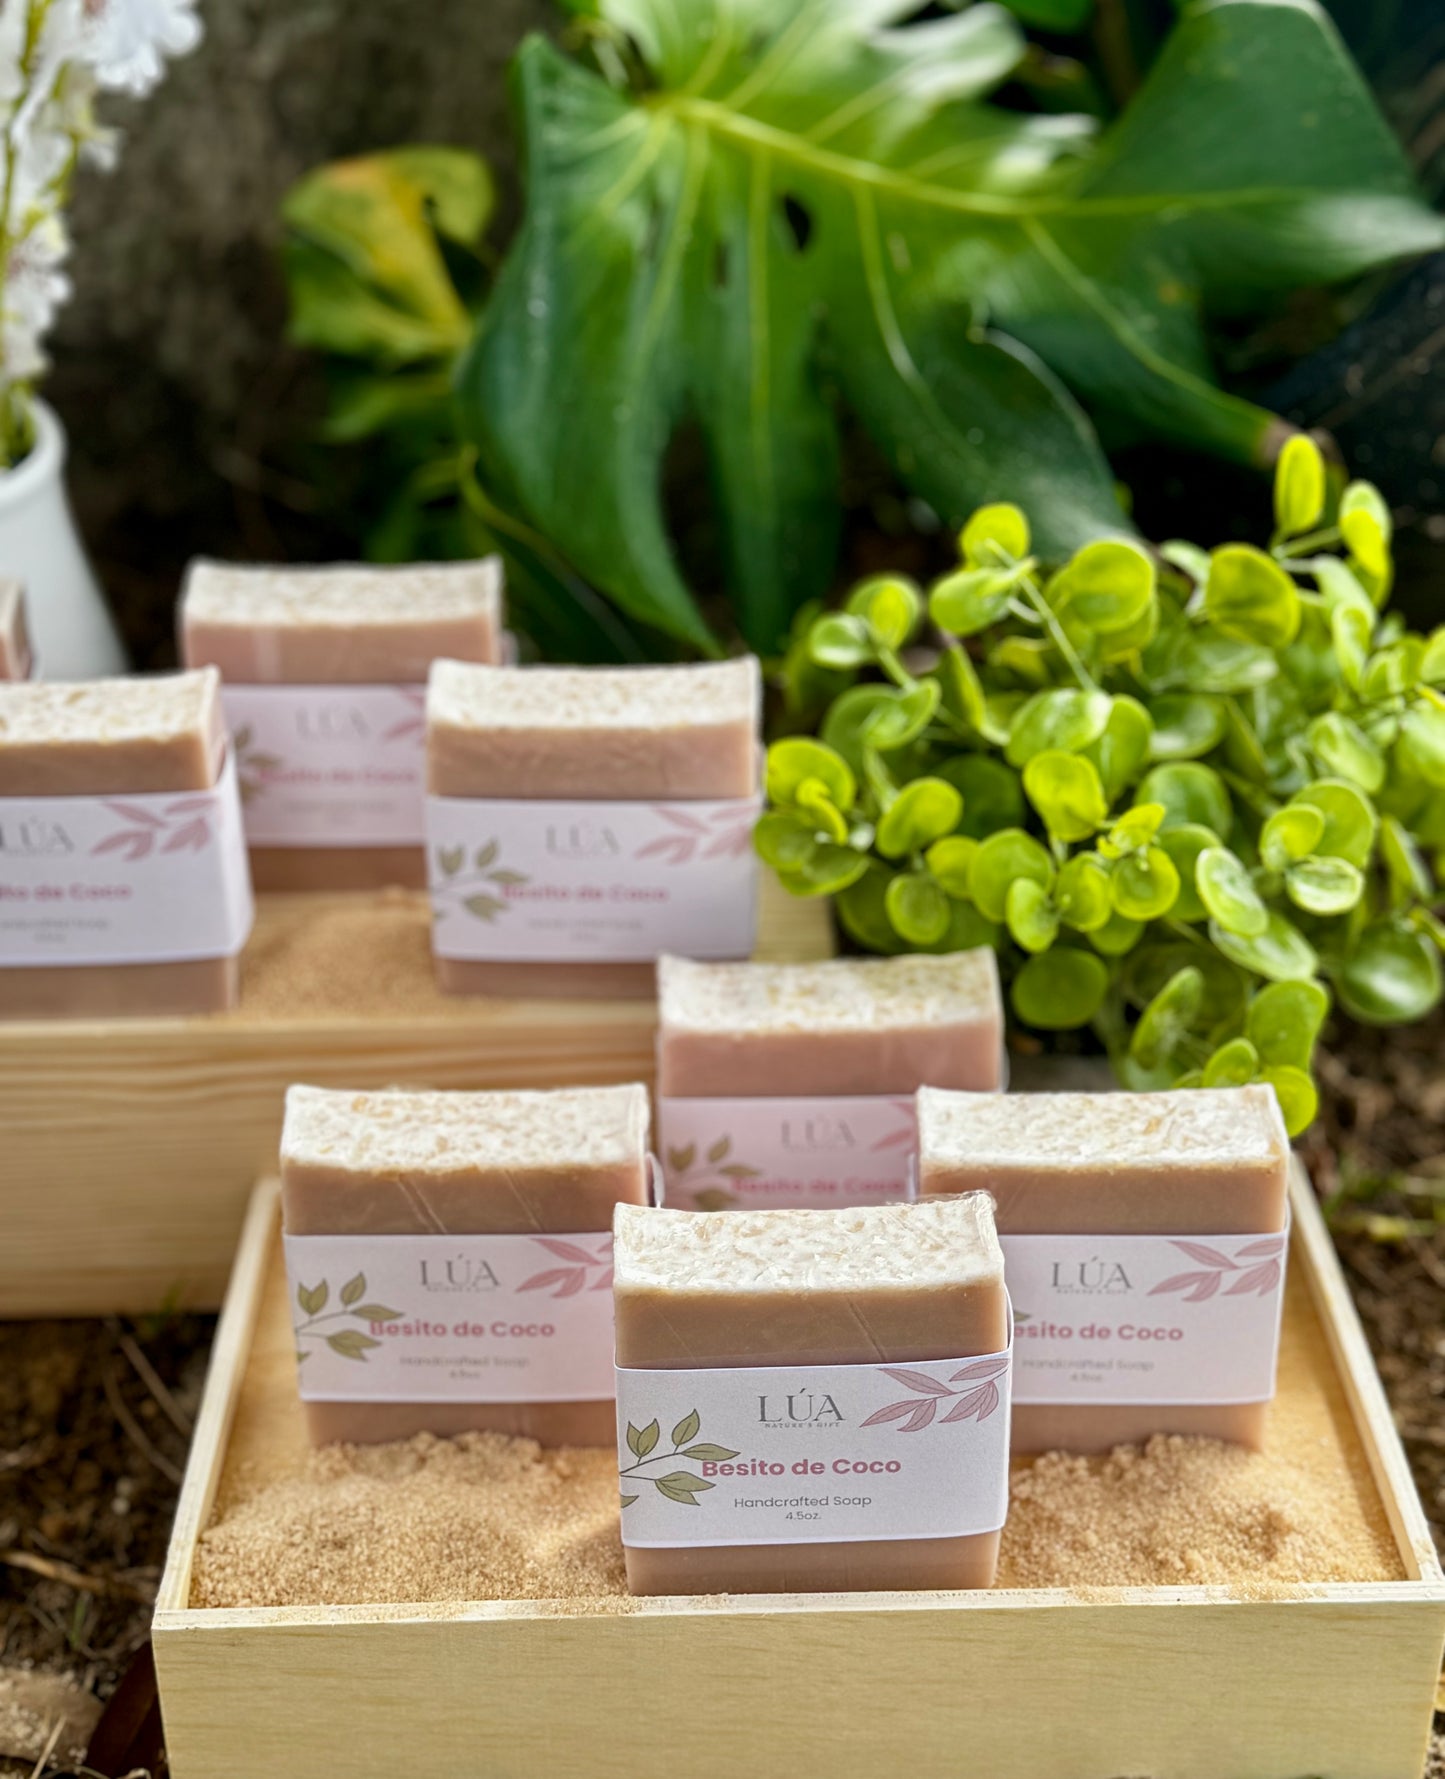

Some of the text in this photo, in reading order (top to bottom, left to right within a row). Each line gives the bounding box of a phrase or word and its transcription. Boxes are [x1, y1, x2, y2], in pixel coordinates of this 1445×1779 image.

[419, 1253, 501, 1287] LÚA
[1051, 1256, 1134, 1289] LÚA
[369, 1319, 555, 1338] Besito de Coco
[1014, 1321, 1184, 1341] esito de Coco
[758, 1387, 845, 1422] LÚA
[702, 1458, 902, 1477] Besito de Coco
[734, 1495, 873, 1509] Handcrafted Soap
